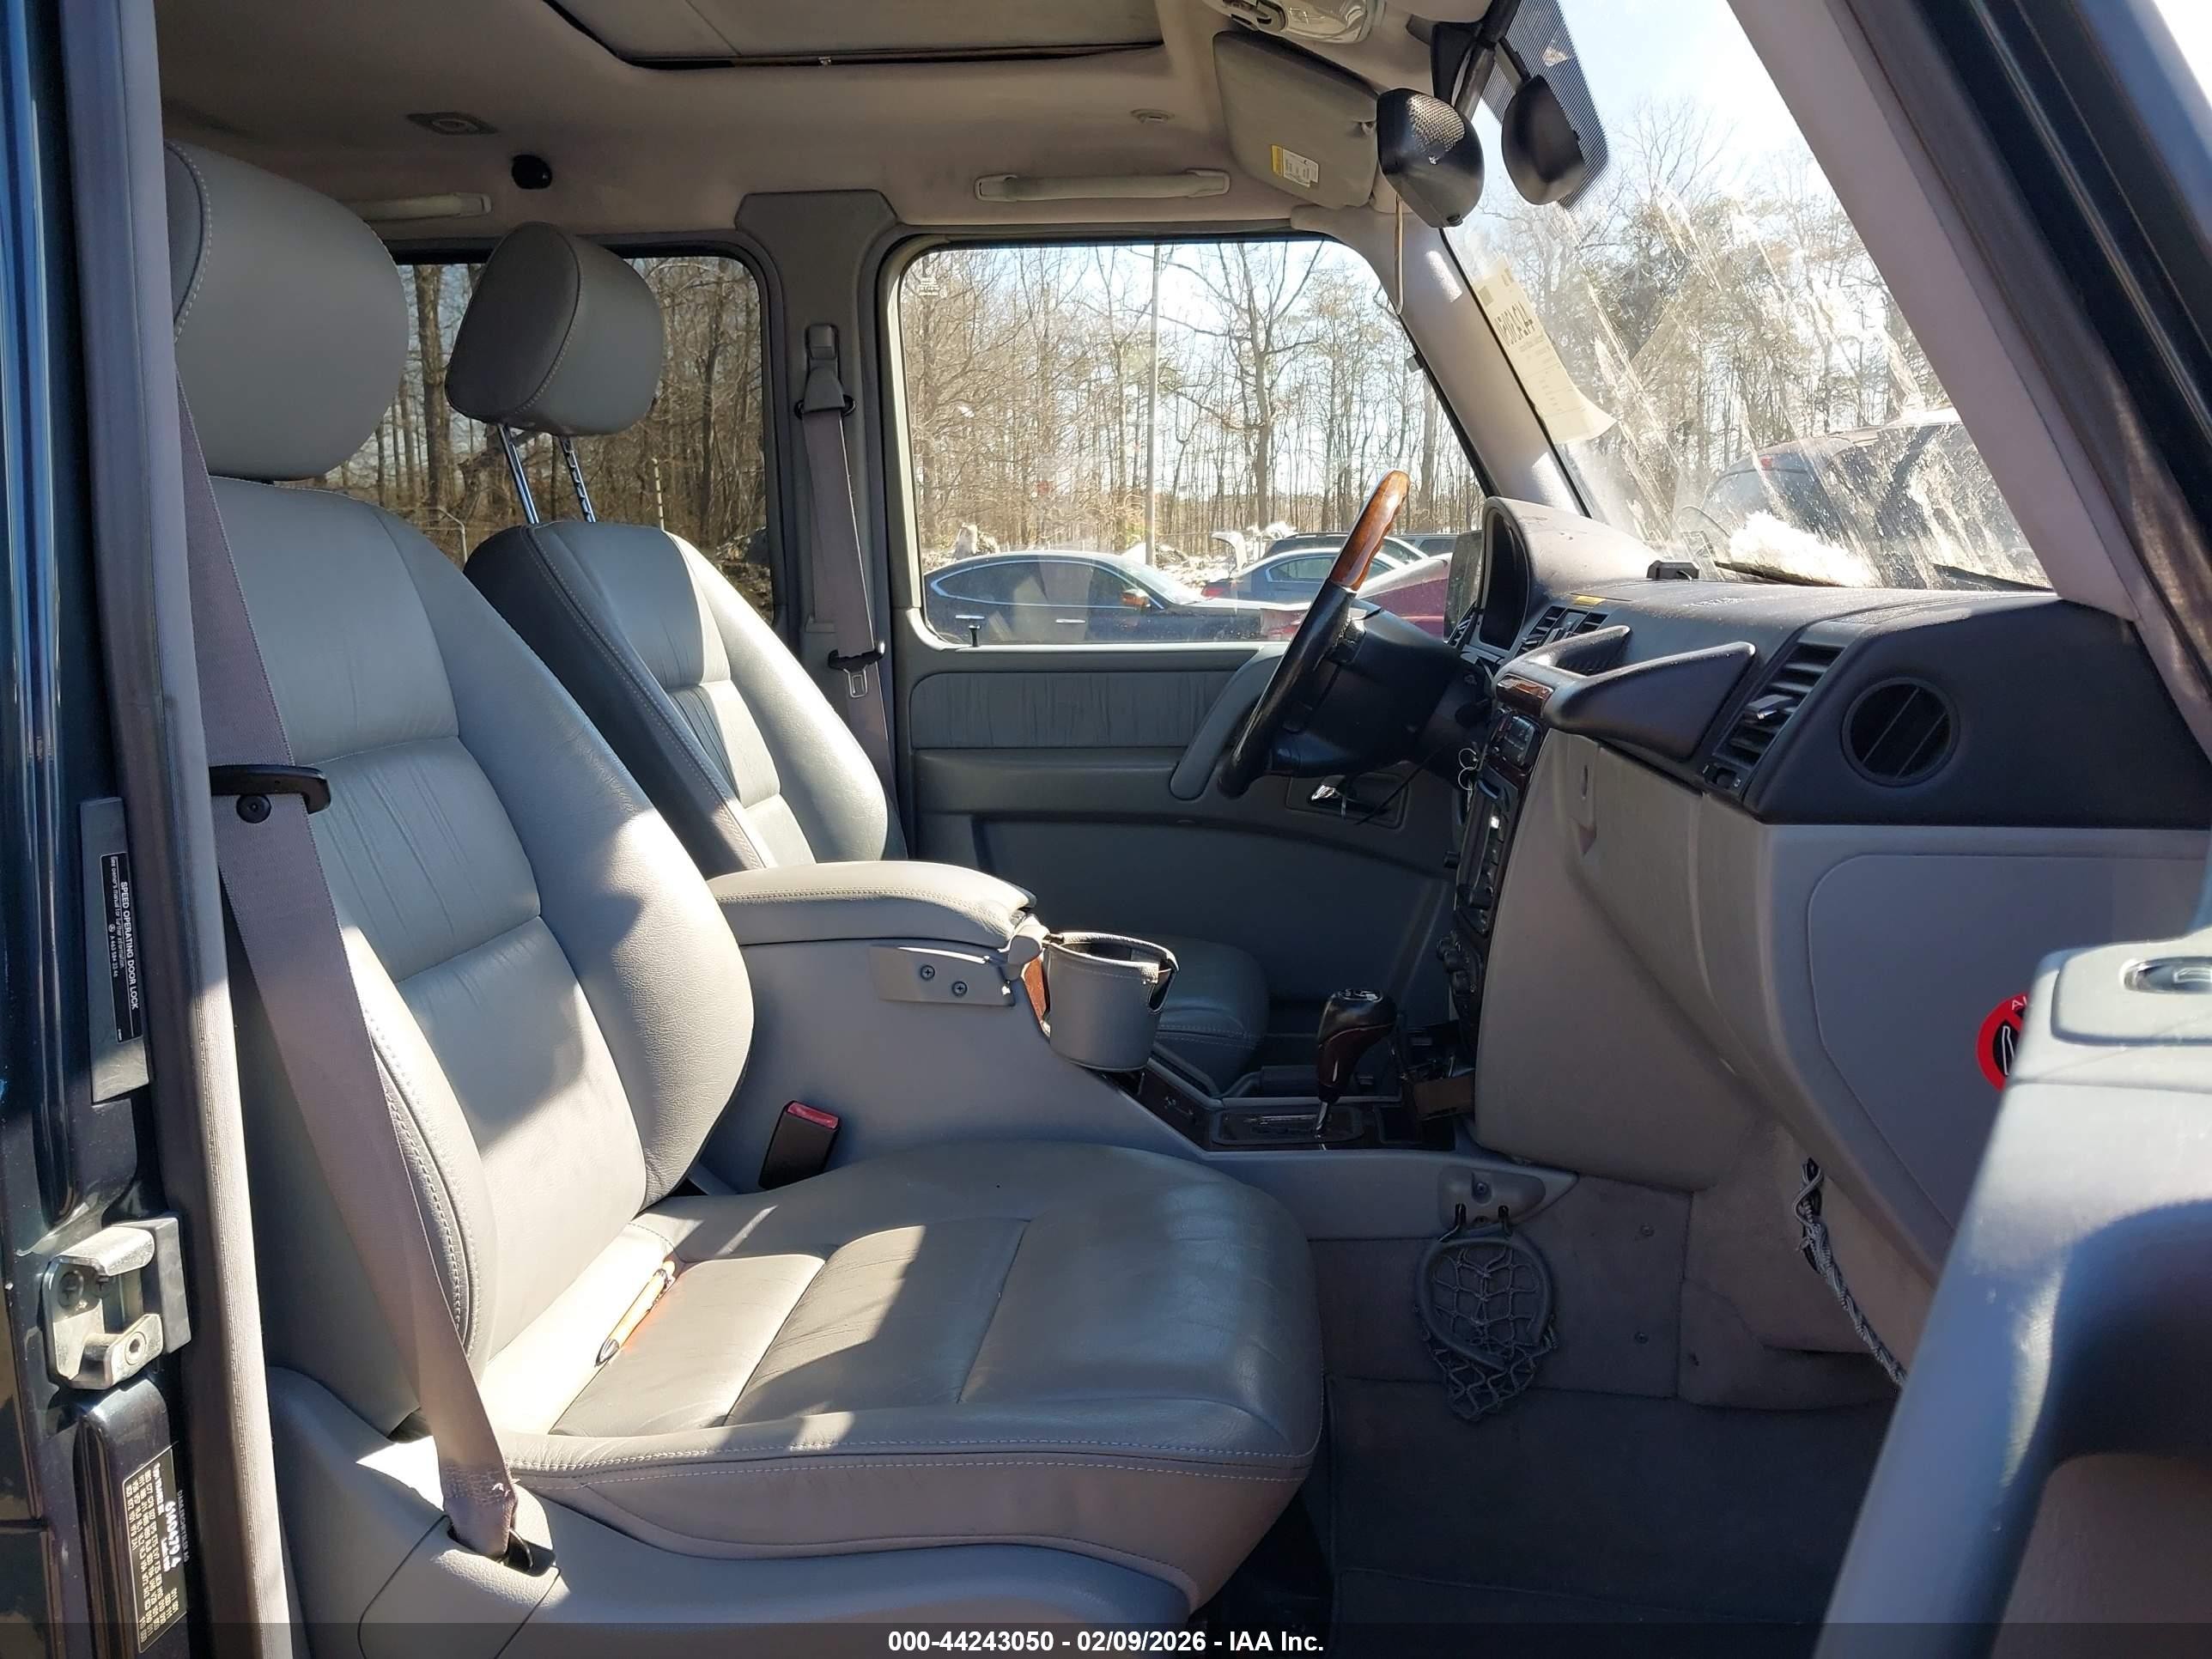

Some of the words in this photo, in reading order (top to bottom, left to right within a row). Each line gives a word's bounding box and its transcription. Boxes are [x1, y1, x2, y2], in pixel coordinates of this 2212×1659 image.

[120, 883, 129, 908] SPEED
[123, 911, 133, 958] OPERATING
[127, 960, 136, 985] DOOR
[130, 987, 138, 1010] LOCK
